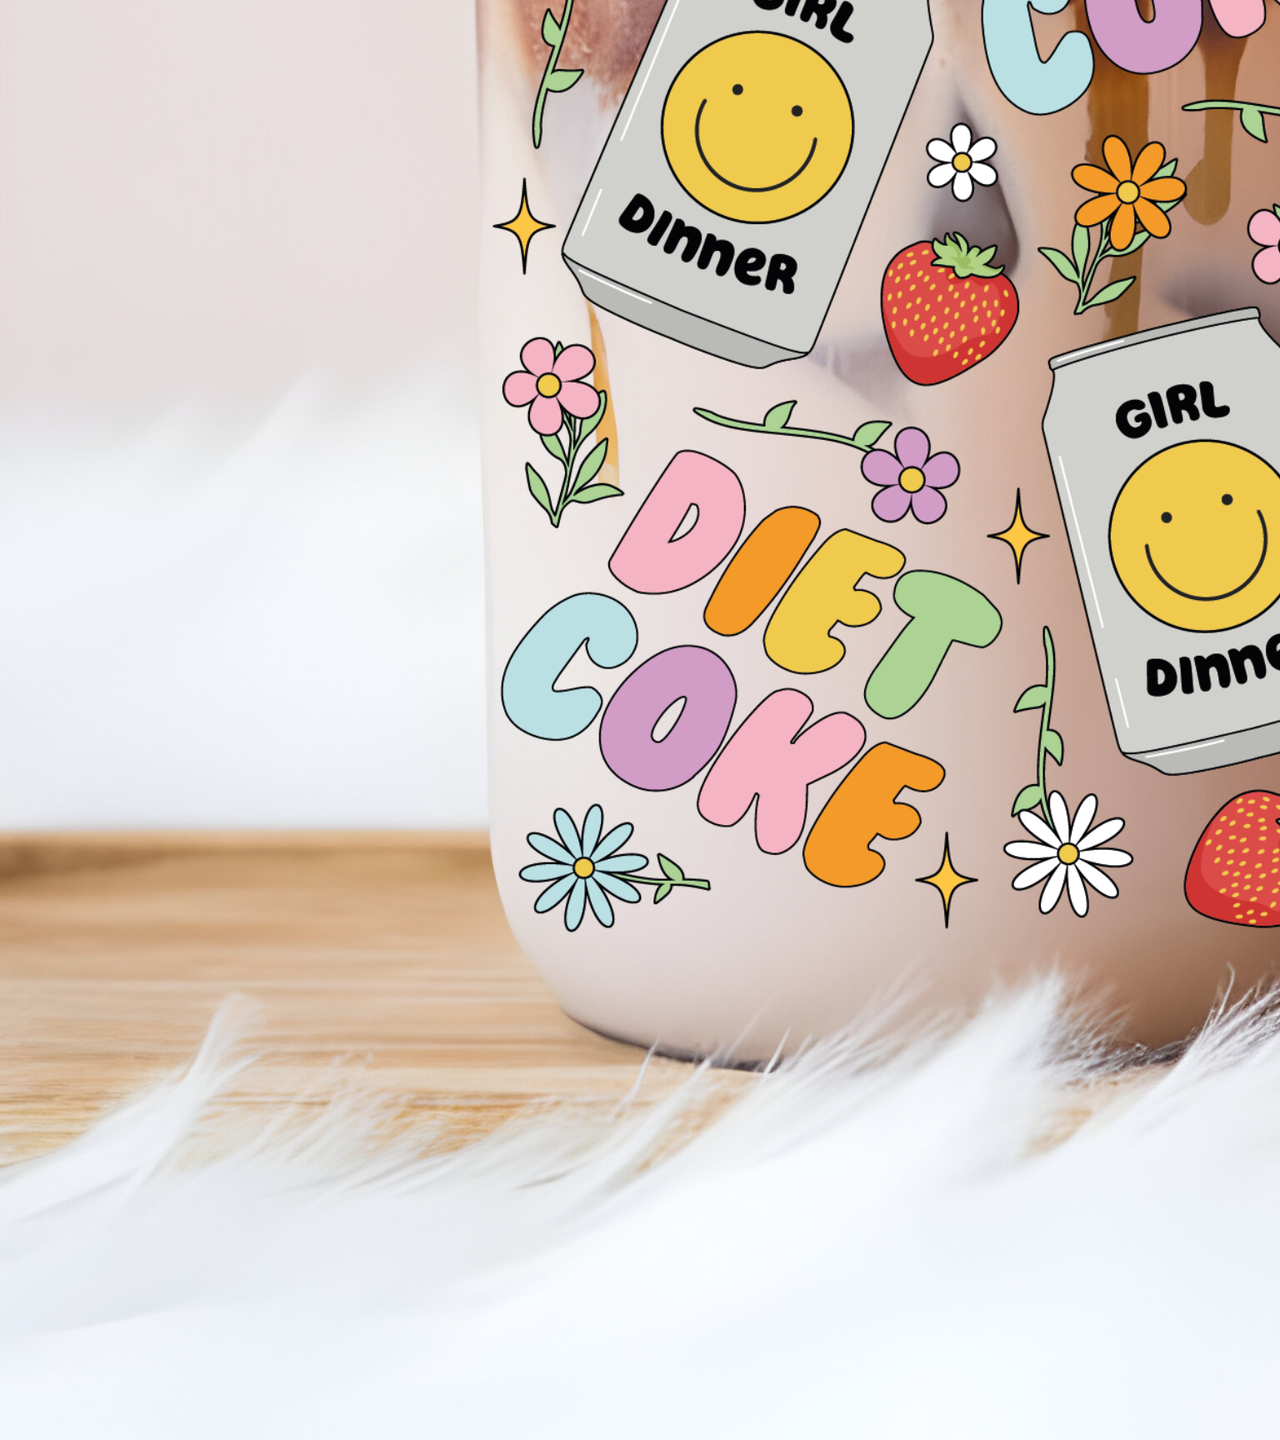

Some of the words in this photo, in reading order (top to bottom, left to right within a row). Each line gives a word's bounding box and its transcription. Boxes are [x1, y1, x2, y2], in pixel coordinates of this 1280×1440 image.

[1116, 381, 1230, 438] GIRL
[607, 449, 1002, 720] DIET
[500, 591, 947, 887] COKE
